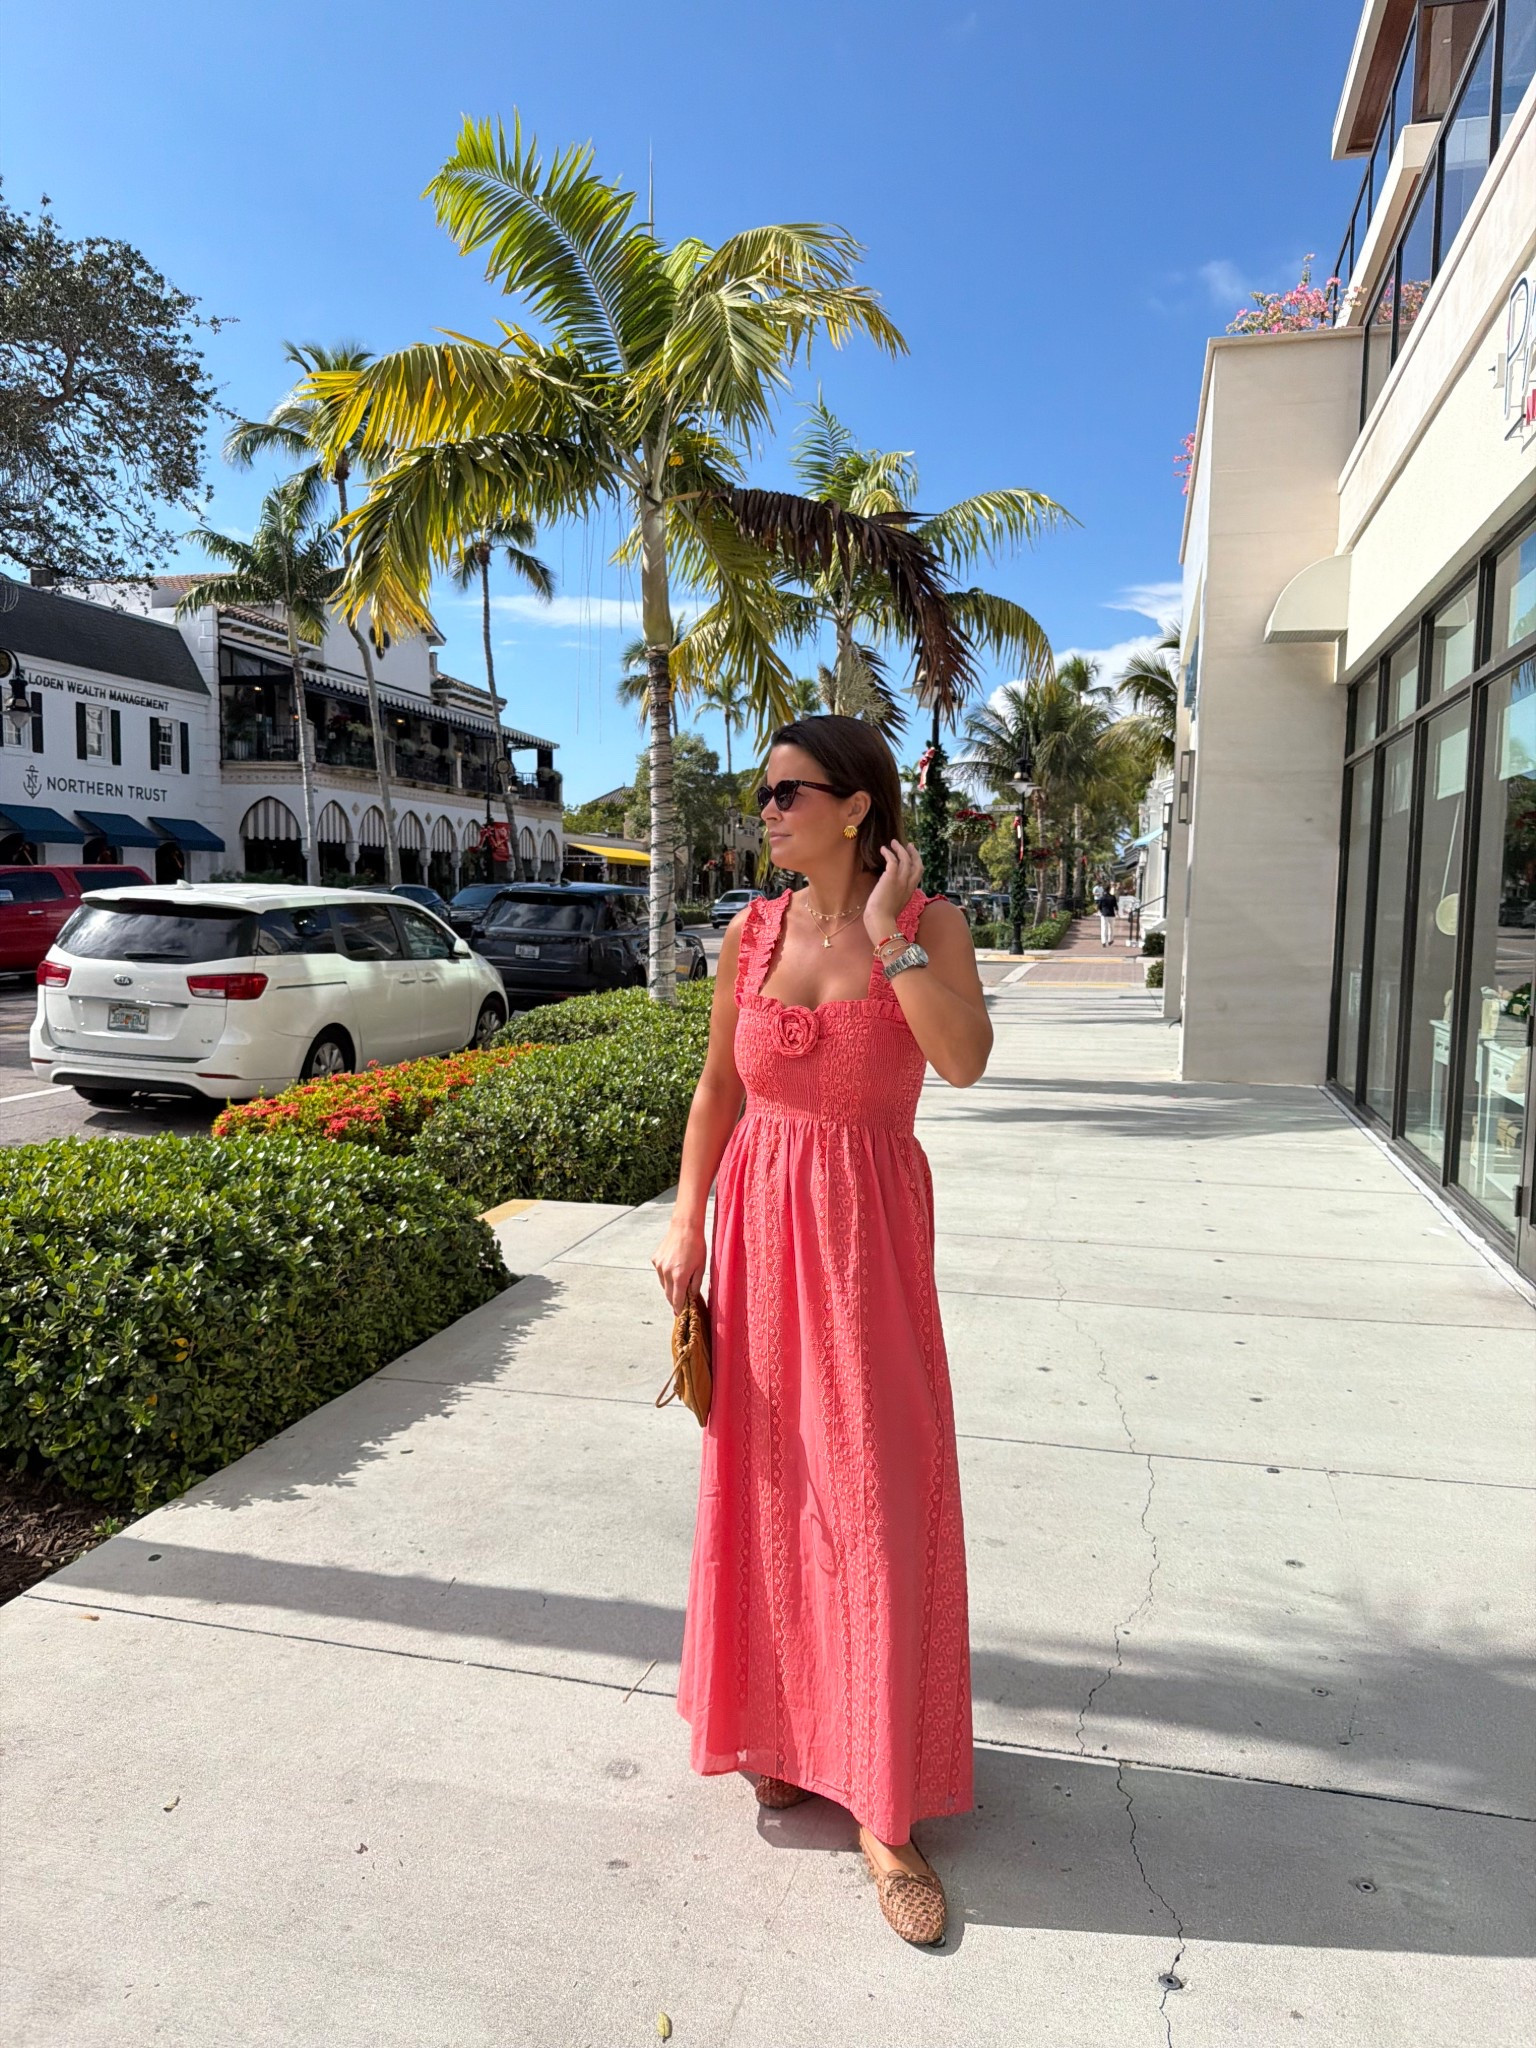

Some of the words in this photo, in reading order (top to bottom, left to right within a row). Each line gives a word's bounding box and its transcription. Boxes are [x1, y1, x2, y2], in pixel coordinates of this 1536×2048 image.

[28, 672, 64, 691] LODEN
[67, 681, 107, 699] WEALTH
[109, 690, 169, 711] MANAGEMENT
[46, 776, 124, 798] NORTHERN
[128, 785, 168, 802] TRUST
[115, 976, 131, 985] KIA
